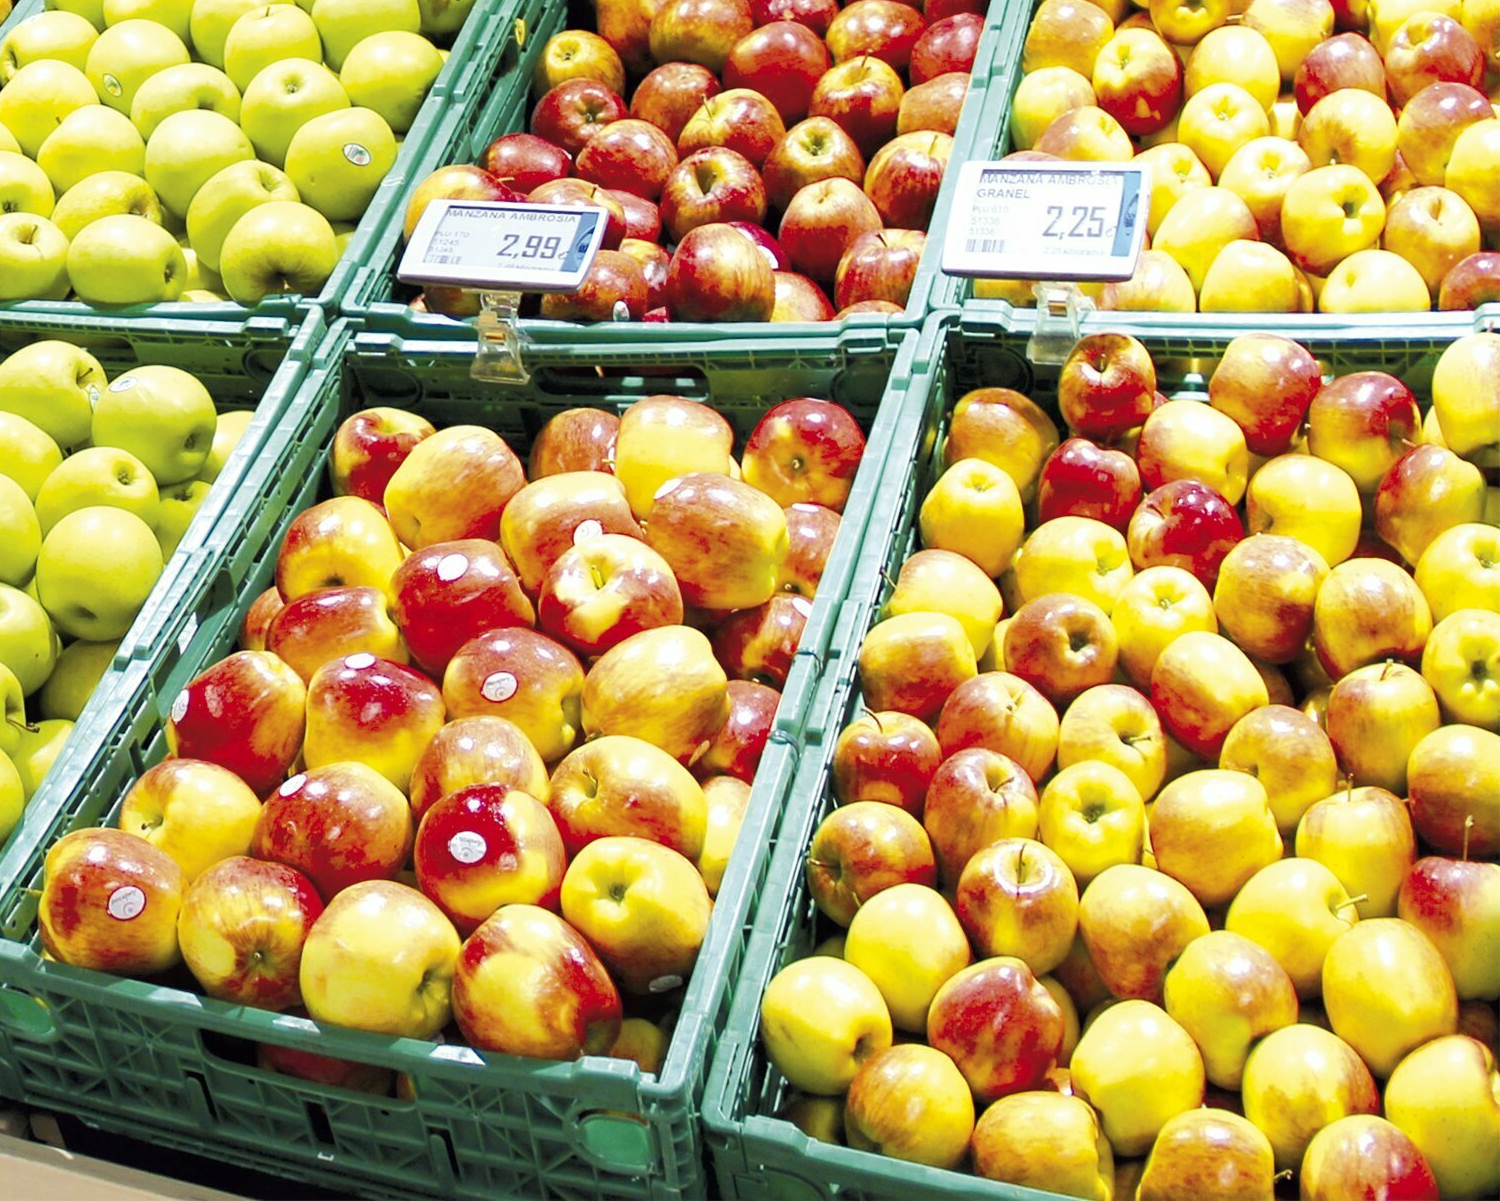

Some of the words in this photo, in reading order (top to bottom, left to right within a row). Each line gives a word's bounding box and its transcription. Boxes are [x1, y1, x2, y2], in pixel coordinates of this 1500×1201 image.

[978, 173, 1044, 185] MANZANA
[976, 188, 1032, 199] GRANEL
[446, 209, 506, 220] MANZANA
[509, 212, 577, 223] AMBROSIA
